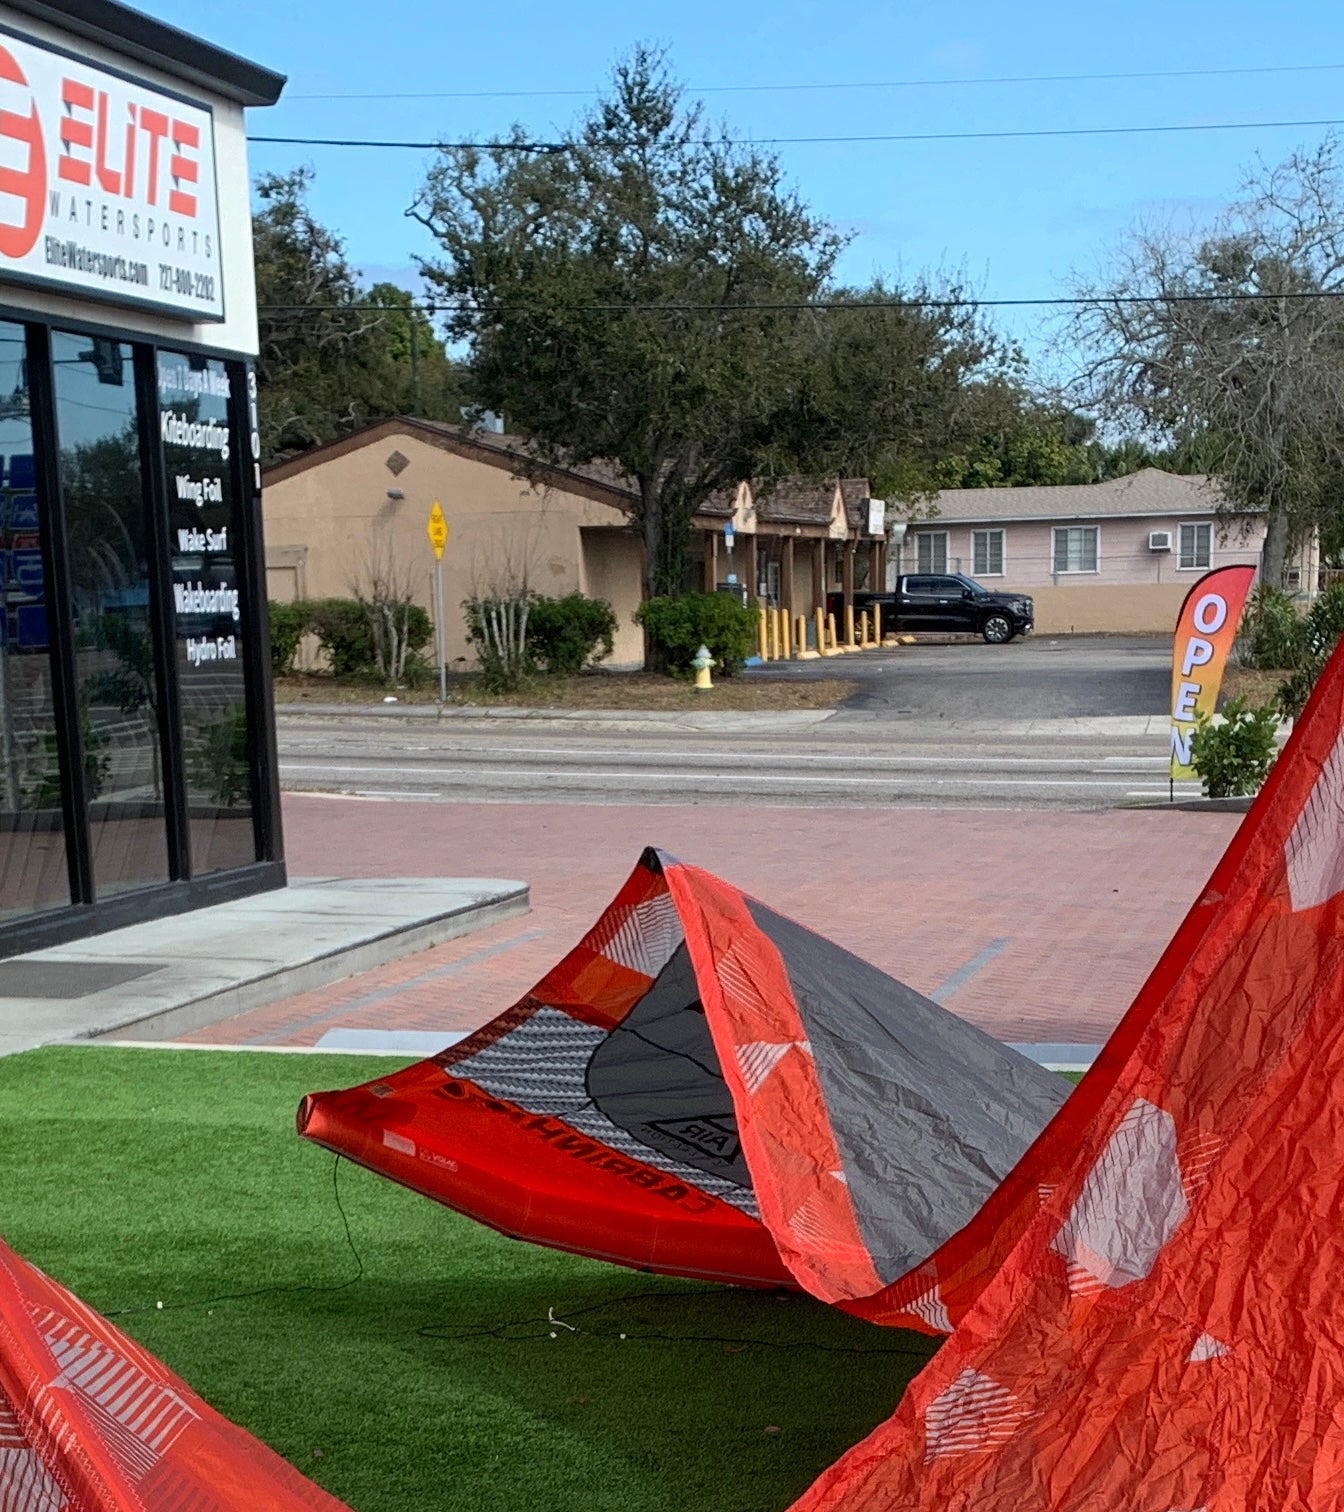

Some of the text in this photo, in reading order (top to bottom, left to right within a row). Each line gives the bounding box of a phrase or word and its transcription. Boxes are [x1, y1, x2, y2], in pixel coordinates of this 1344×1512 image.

[49, 189, 213, 259] WATERSPORTS
[161, 410, 230, 460] Kiteboarding
[175, 474, 223, 507] Wing Foil
[177, 526, 227, 551] Wake Surf
[173, 581, 240, 621] Wakeboarding
[186, 635, 236, 667] Hydro Foil
[1171, 593, 1228, 767] OPEN
